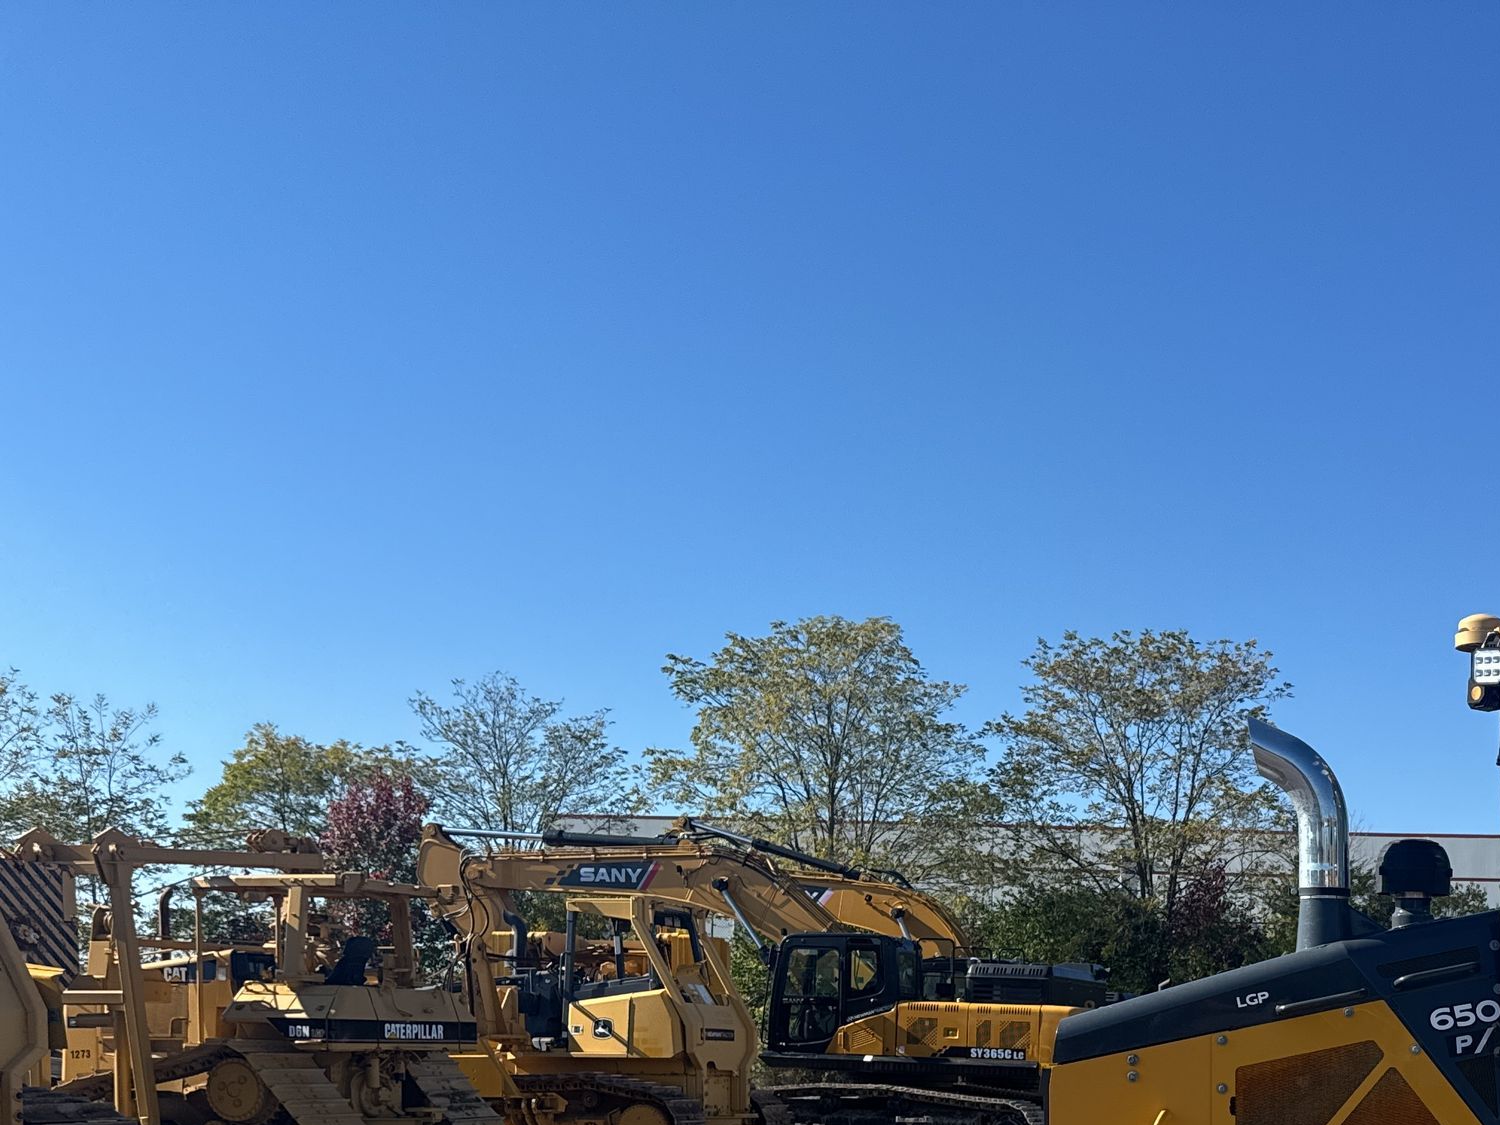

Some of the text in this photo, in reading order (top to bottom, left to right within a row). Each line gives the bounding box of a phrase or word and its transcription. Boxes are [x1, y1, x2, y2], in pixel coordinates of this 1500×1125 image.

[580, 867, 642, 883] SANY
[163, 966, 188, 982] CAT
[1236, 991, 1269, 1008] LGP
[1429, 999, 1500, 1031] 650
[288, 1025, 310, 1038] D6N
[384, 1023, 444, 1040] CATERPILLAR
[70, 1049, 91, 1060] 1273
[970, 1047, 1025, 1060] SY365C LC
